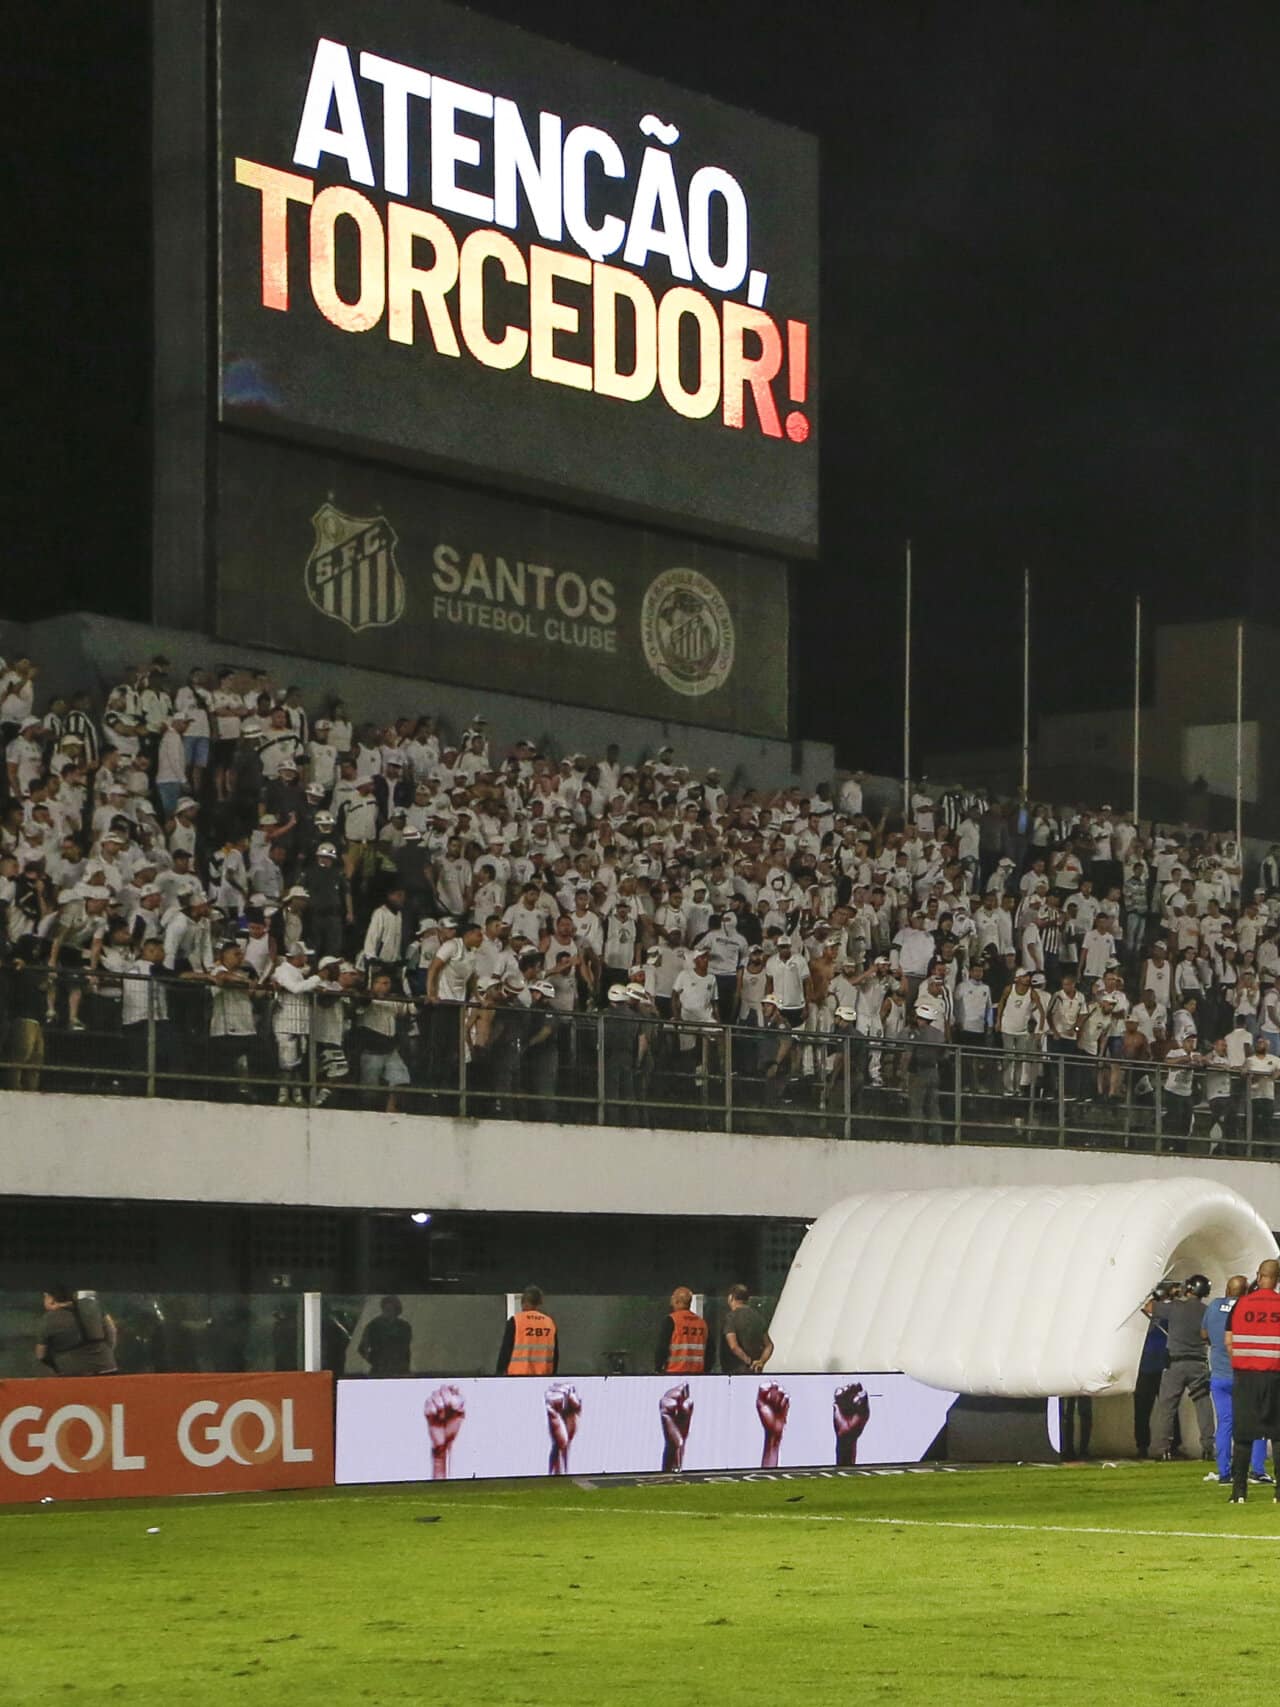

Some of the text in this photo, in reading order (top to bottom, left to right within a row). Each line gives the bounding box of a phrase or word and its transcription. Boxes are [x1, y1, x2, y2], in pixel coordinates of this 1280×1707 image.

[293, 38, 768, 307] ATENÇÃO,
[235, 158, 809, 442] TORCEDOR!
[432, 544, 617, 624] SANTOS
[433, 596, 617, 653] FUTEBOL CLUBE
[525, 1327, 551, 1337] 287
[1244, 1311, 1280, 1323] 025
[0, 1404, 146, 1476] GOL
[177, 1398, 313, 1467] GOL
